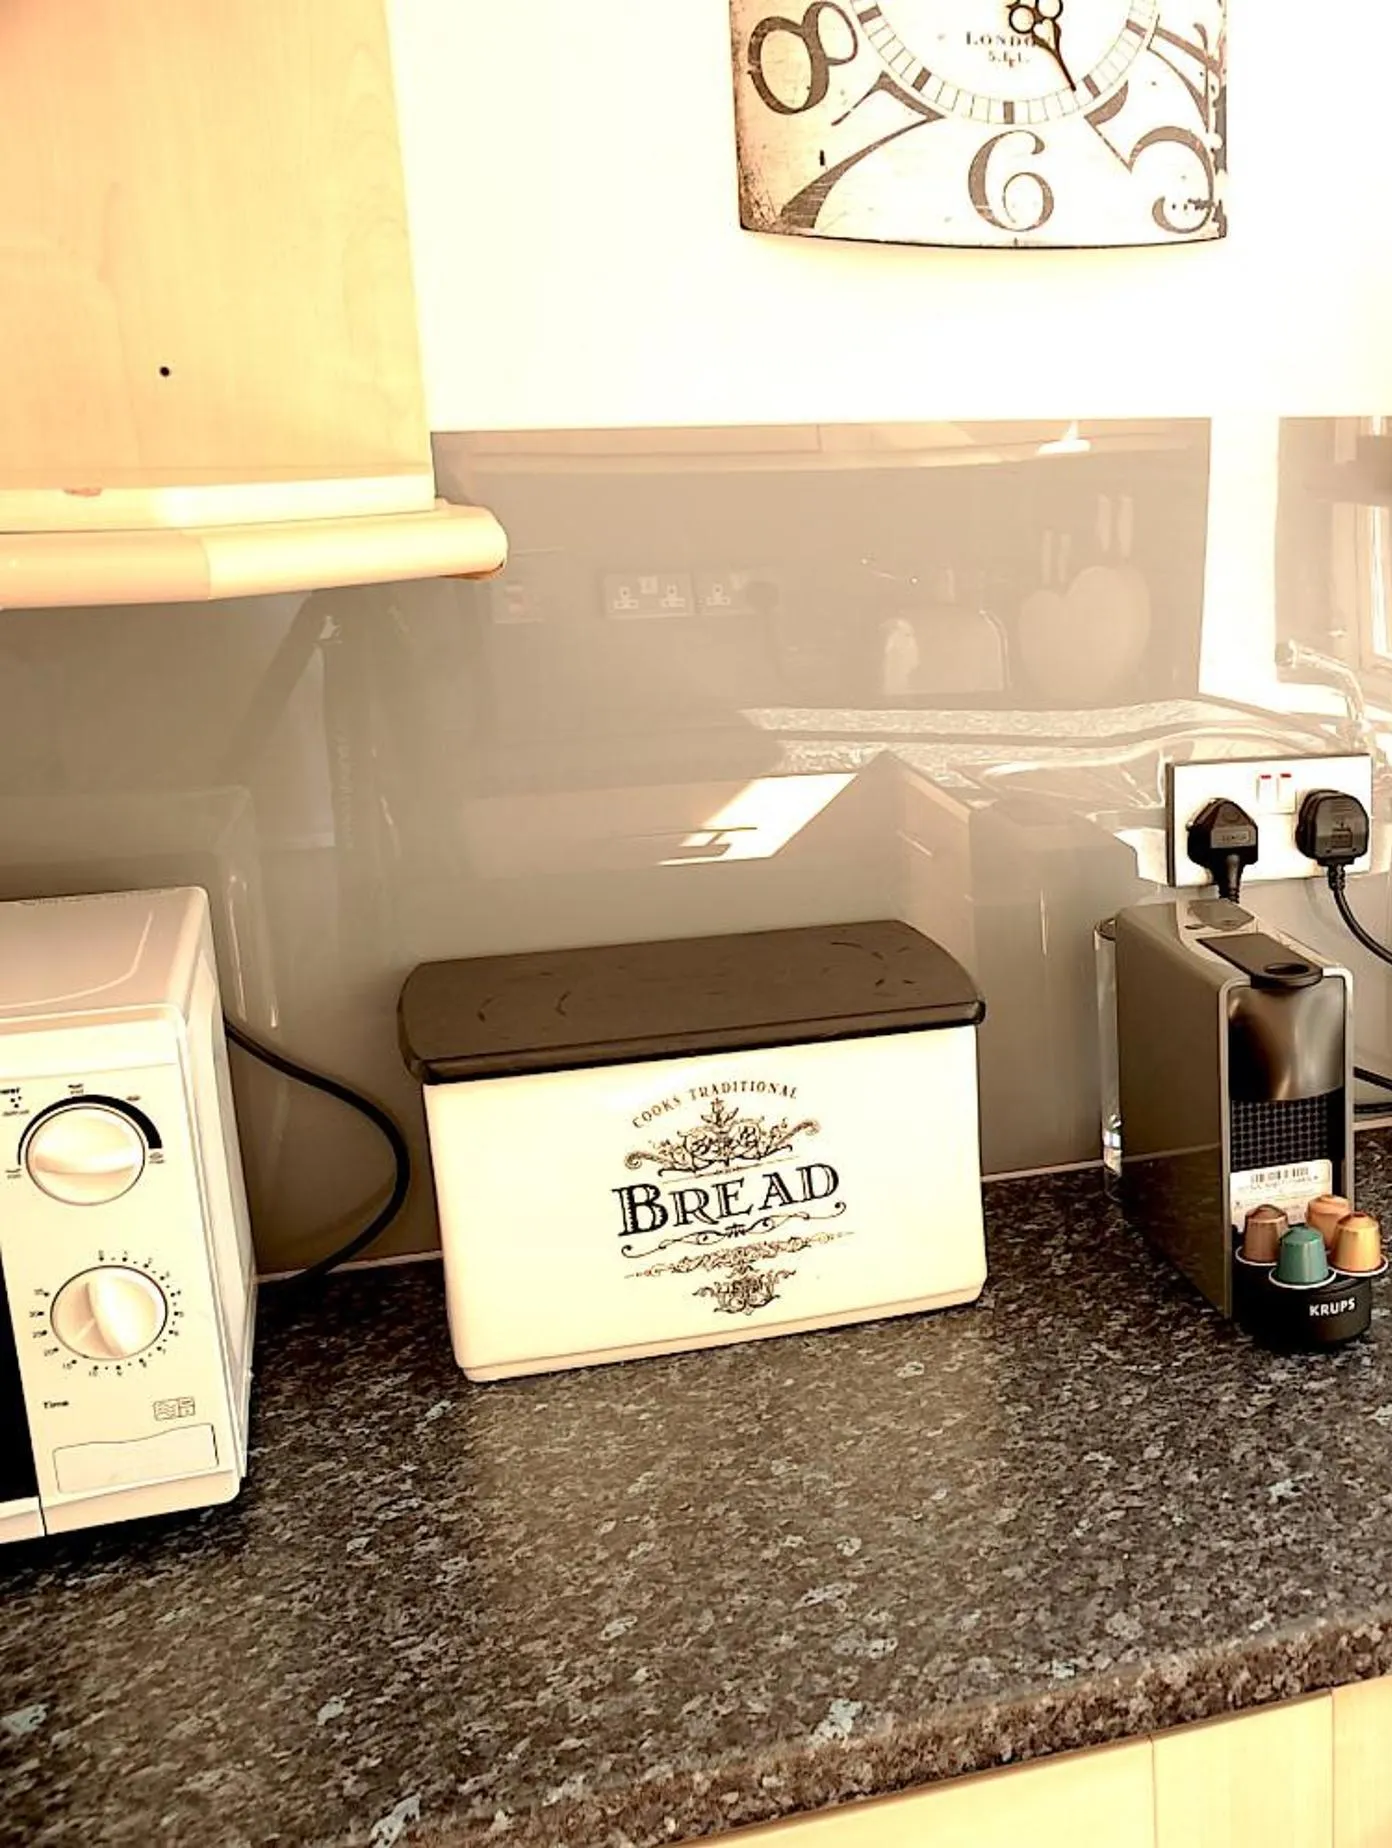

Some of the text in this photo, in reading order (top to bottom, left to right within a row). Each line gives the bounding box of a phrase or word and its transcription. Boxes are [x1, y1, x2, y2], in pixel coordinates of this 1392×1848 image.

[747, 0, 858, 116] 8
[965, 31, 1050, 48] LONDO
[780, 70, 946, 229] 7
[968, 130, 1055, 232] 6
[1084, 80, 1214, 234] 5
[631, 1080, 799, 1129] COOKS TRADITIONAL
[611, 1162, 840, 1237] BREAD
[1308, 1297, 1356, 1317] KRUPS
